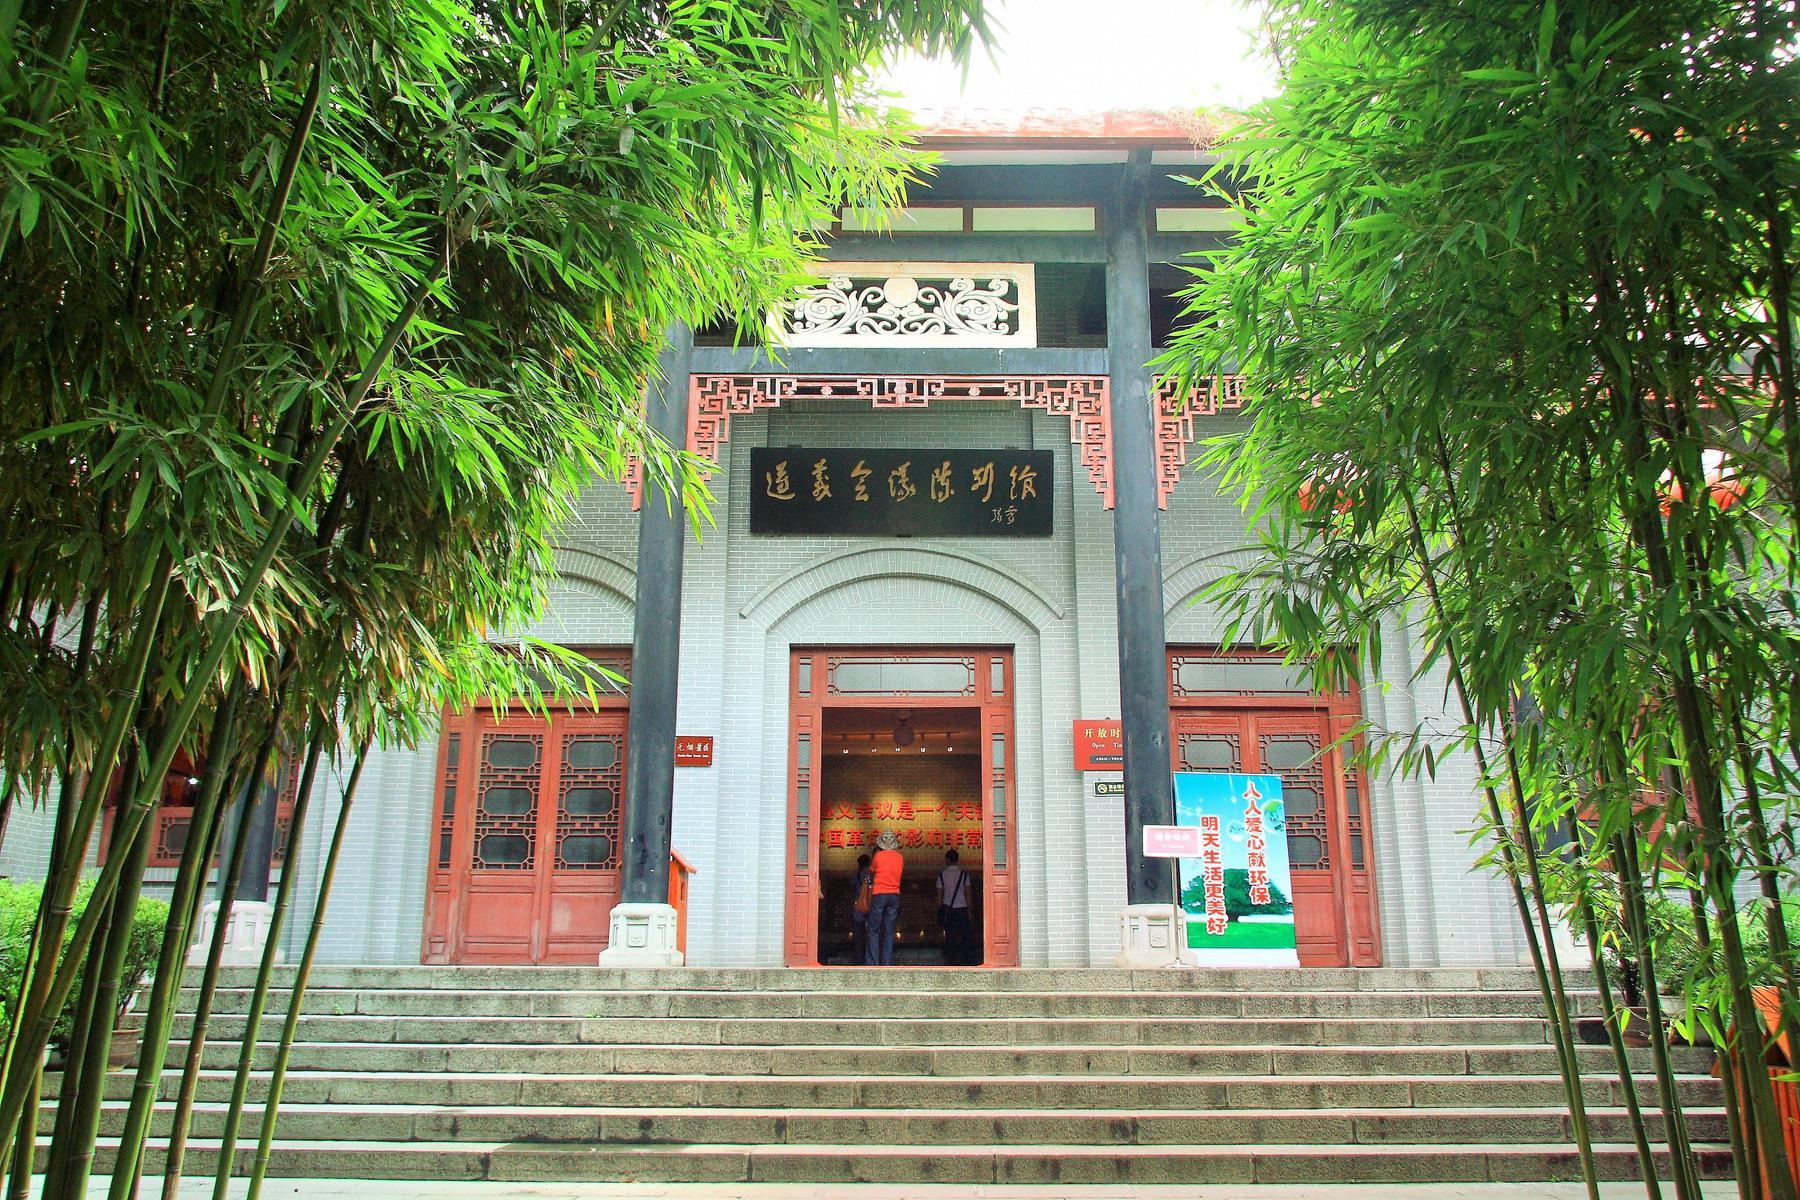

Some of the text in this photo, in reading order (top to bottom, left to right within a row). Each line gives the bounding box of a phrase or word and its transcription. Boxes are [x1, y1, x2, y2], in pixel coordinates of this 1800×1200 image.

[1083, 727, 1121, 738] 开放时
[1201, 816, 1226, 934] 明天生活更美好
[1243, 782, 1270, 904] 人人爱心献环保
